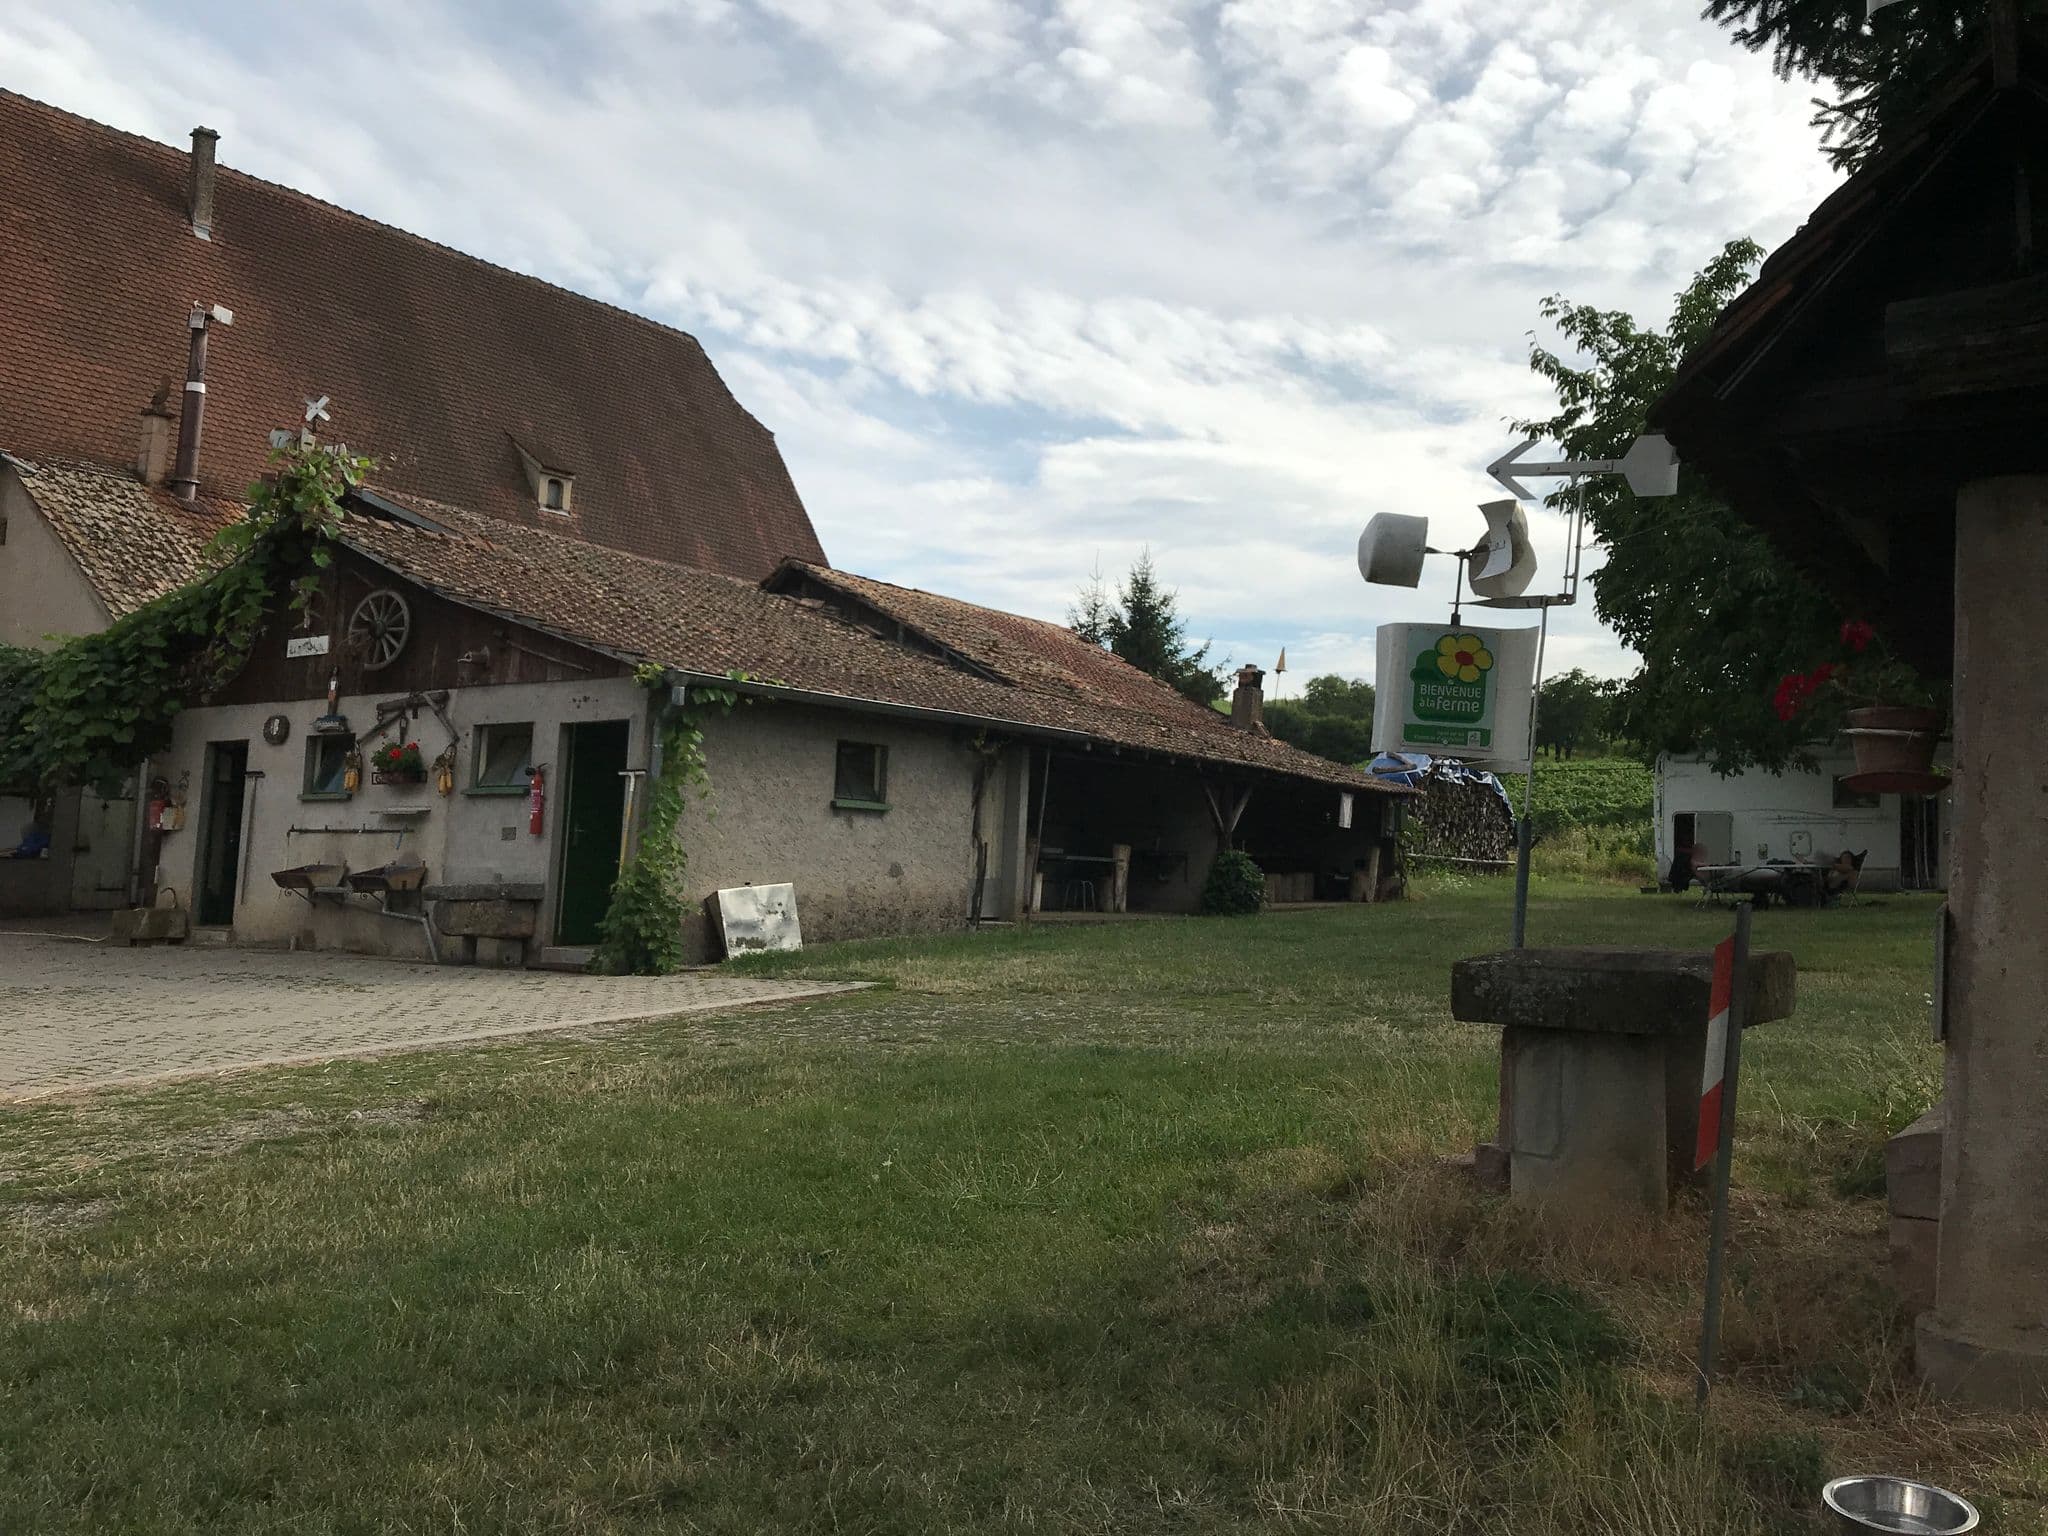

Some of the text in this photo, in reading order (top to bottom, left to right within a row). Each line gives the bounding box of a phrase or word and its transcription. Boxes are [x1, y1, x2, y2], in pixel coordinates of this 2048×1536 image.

[1420, 684, 1481, 698] BIENVENUE
[1426, 697, 1435, 708] la
[1437, 696, 1480, 712] ferme
